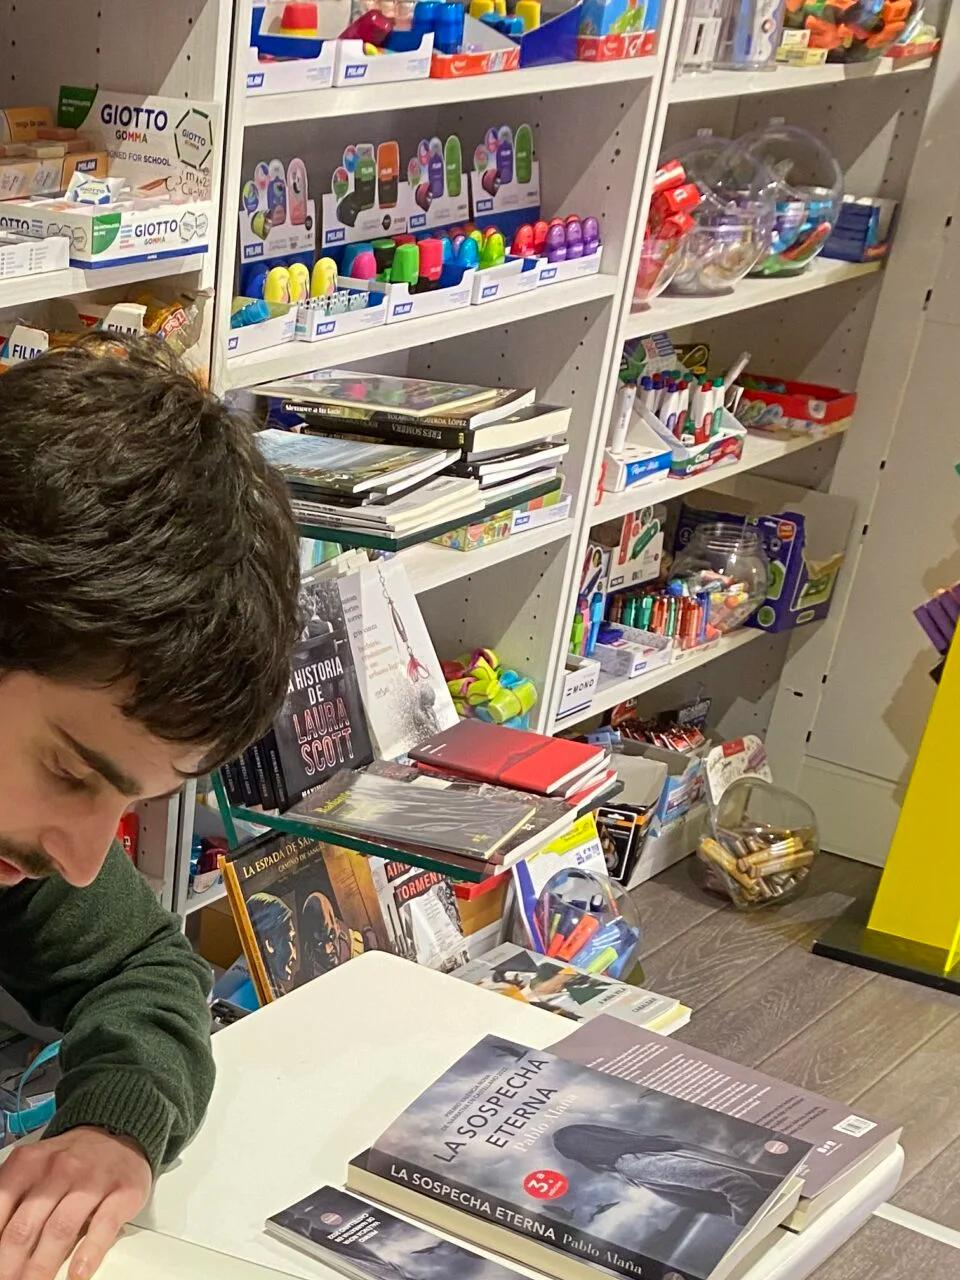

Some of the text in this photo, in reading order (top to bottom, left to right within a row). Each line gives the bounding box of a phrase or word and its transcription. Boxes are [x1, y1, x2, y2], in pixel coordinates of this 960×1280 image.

[101, 104, 168, 132] GIOTTO
[115, 130, 148, 144] GOMMA
[182, 129, 206, 146] GIOTTO
[128, 153, 172, 167] FOR SCHOOL
[134, 219, 178, 238] GIOTTO
[294, 656, 344, 691] HISTORIA
[307, 684, 324, 705] DE
[293, 697, 350, 745] LAURA
[301, 726, 354, 775] SCOTT
[242, 866, 256, 879] LA
[255, 851, 286, 873] ESPADA
[285, 843, 297, 857] DE
[433, 1137, 466, 1163] LA
[457, 1058, 550, 1139] SOSPECHA
[485, 1087, 558, 1149] ETERNA
[513, 1120, 550, 1153] Pablo
[390, 1164, 643, 1275] LA SOSPECHA ETERNA Pablo Alaña
